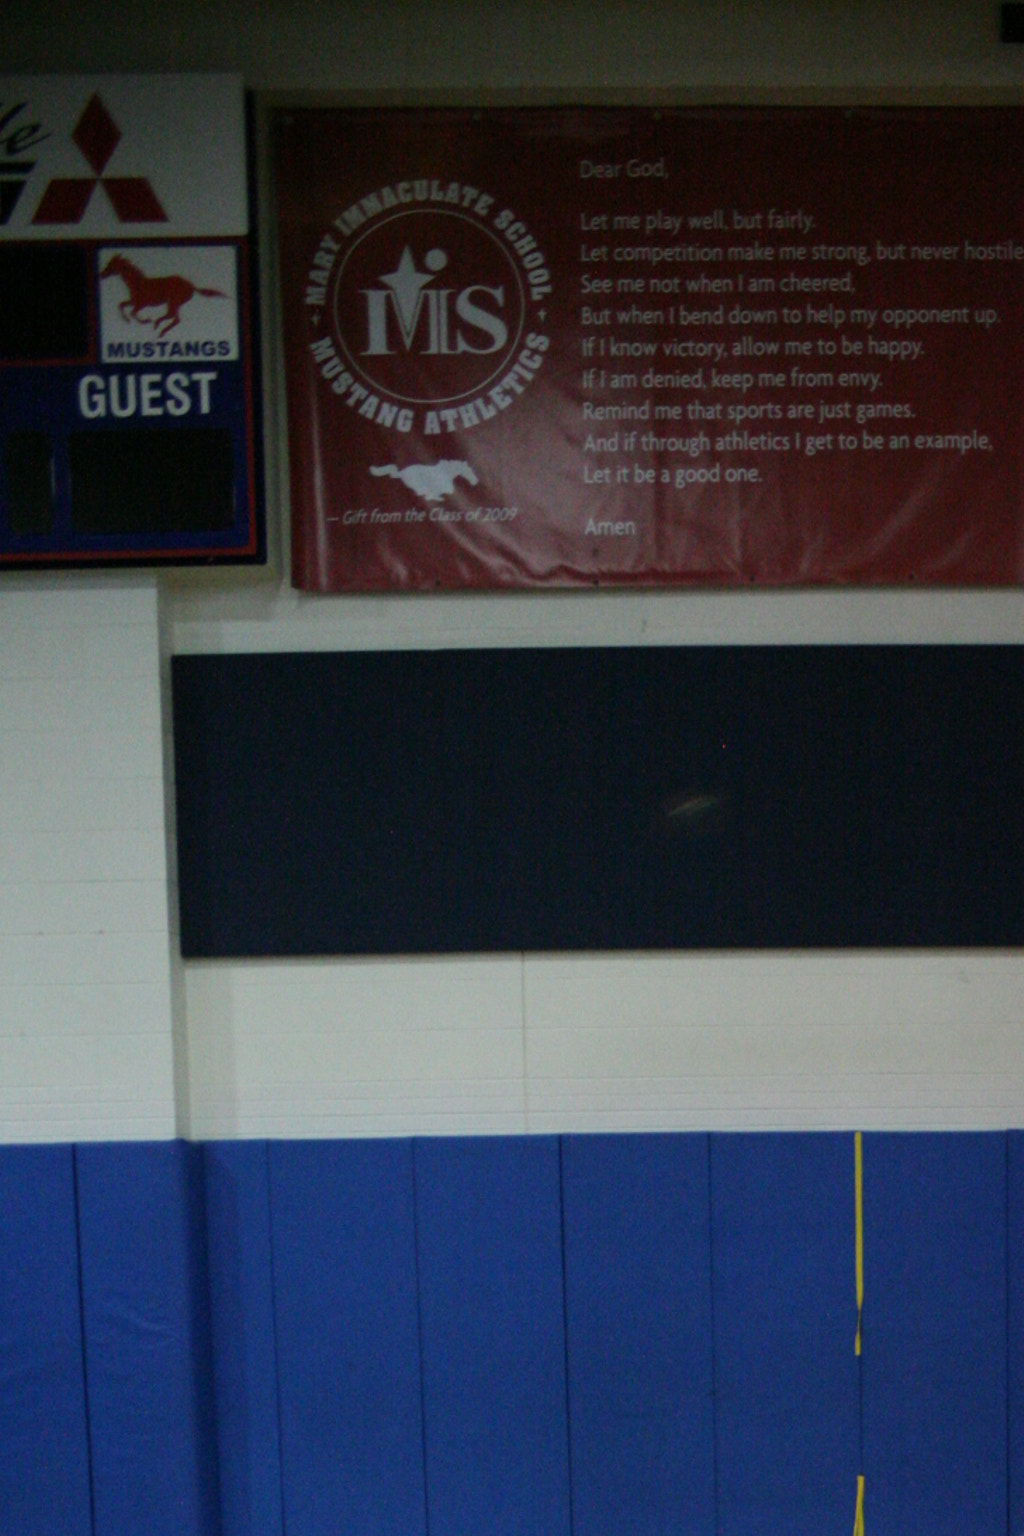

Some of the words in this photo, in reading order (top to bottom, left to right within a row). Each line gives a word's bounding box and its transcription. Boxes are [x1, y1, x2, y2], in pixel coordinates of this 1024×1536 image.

[580, 160, 622, 178] Dear
[626, 157, 669, 179] God,
[580, 212, 608, 230] Let
[613, 215, 640, 229] me
[645, 210, 683, 235] play
[732, 210, 762, 229] but
[767, 208, 816, 233] fairly.
[304, 233, 341, 305] MARY
[334, 179, 495, 237] IMMACULATE
[493, 209, 552, 301] SCHOOL
[580, 244, 608, 262] Let
[613, 243, 723, 266] competition
[727, 240, 774, 261] make
[779, 246, 806, 260] me
[876, 241, 906, 260] but
[910, 246, 959, 260] never
[581, 275, 613, 293] See
[617, 278, 645, 292] me
[650, 275, 681, 292] not
[686, 274, 733, 292] when
[738, 274, 743, 291] I
[749, 278, 775, 291] am
[779, 273, 855, 294] cheered,
[581, 307, 611, 325] But
[616, 305, 664, 324] when
[669, 307, 674, 323] I
[679, 305, 724, 324] bend
[728, 305, 778, 323] down
[782, 307, 801, 323] to
[807, 304, 846, 328] help
[851, 309, 878, 328] my
[882, 307, 969, 328] opponent
[107, 340, 231, 358] MUSTANGS
[582, 337, 596, 356] If
[610, 337, 657, 356] know
[732, 336, 779, 356] allow
[784, 341, 812, 355] me
[817, 339, 836, 355] to
[841, 335, 863, 355] be
[868, 335, 925, 361] happy.
[309, 336, 414, 432] MUSTANG
[424, 332, 550, 435] ATHLETICS
[582, 369, 596, 388] If
[610, 374, 637, 388] am
[711, 369, 754, 393] keep
[758, 373, 785, 387] me
[791, 367, 833, 386] from
[838, 373, 883, 391] envy.
[77, 371, 218, 420] GUEST
[582, 400, 650, 420] Remind
[655, 405, 682, 419] me
[687, 400, 722, 419] that
[727, 403, 782, 424] sports
[787, 405, 815, 418] are
[819, 401, 851, 423] just
[856, 403, 916, 424] games.
[585, 432, 618, 452] And
[624, 431, 637, 451] if
[641, 431, 710, 457] through
[715, 431, 790, 450] athletics
[795, 432, 800, 449] I
[805, 433, 833, 456] get
[838, 434, 857, 449] to
[863, 430, 883, 449] be
[889, 435, 909, 449] an
[583, 464, 611, 483] Let
[617, 465, 629, 483] it
[634, 463, 656, 483] be
[661, 469, 670, 482] a
[675, 463, 720, 488] good
[725, 467, 763, 482] one.
[342, 508, 367, 525] Gift
[370, 509, 401, 523] from
[404, 508, 426, 522] the
[429, 508, 462, 522] Class
[482, 507, 518, 522] 2009
[585, 518, 635, 536] Amen
